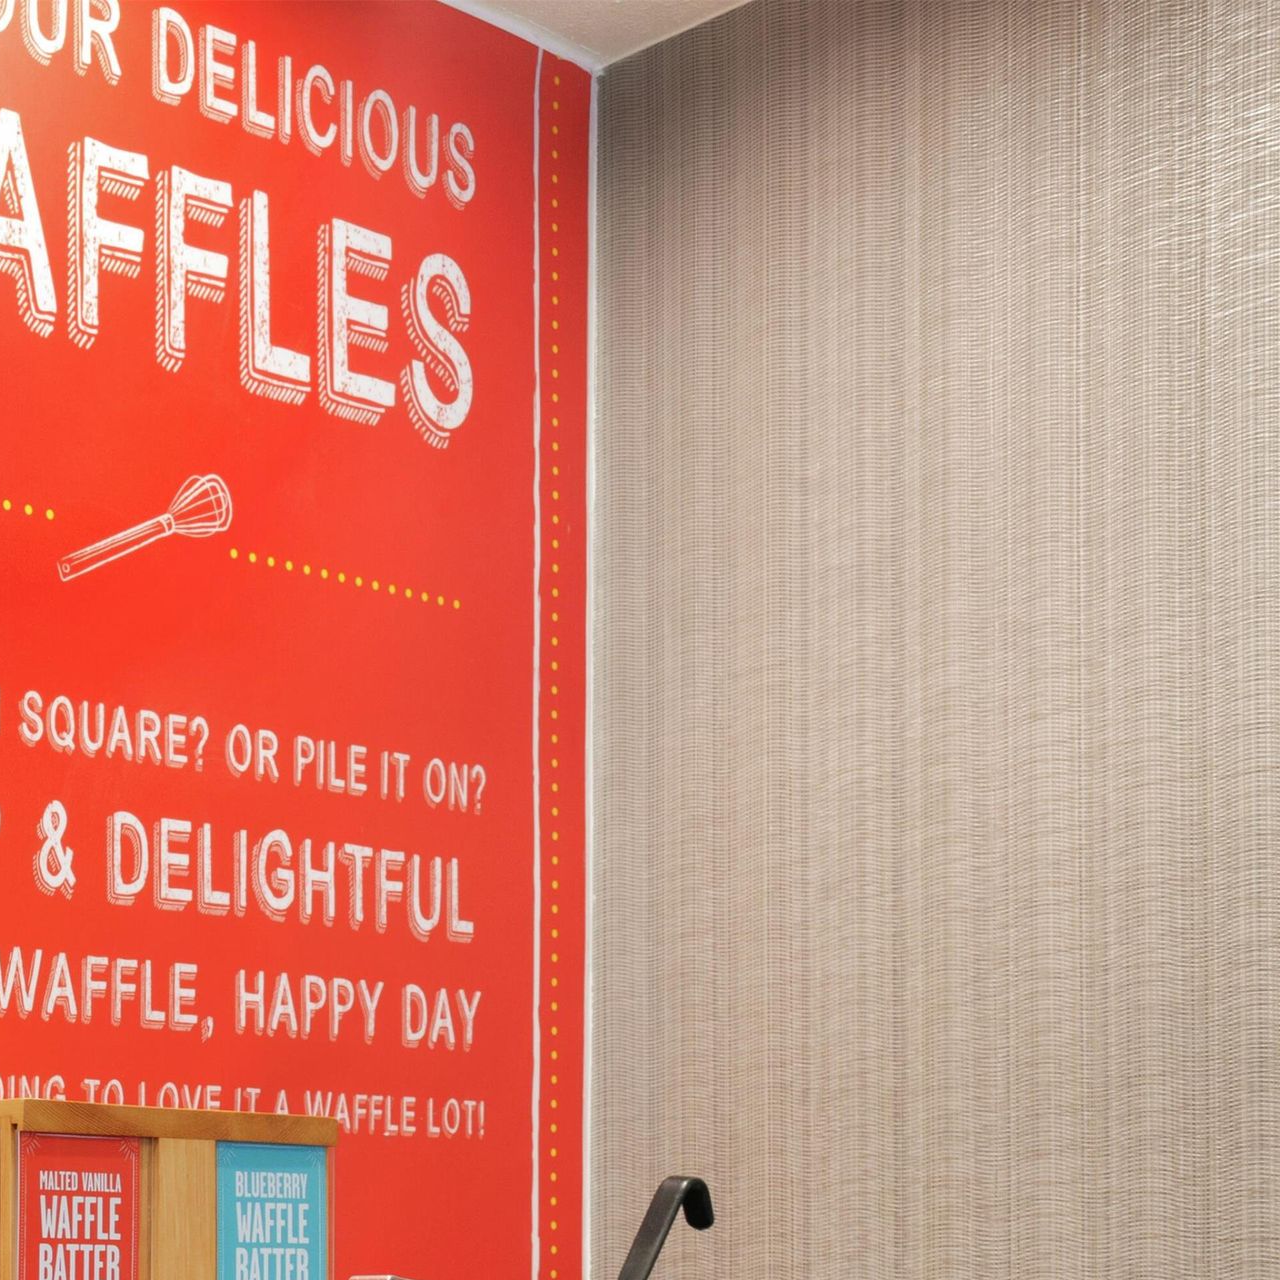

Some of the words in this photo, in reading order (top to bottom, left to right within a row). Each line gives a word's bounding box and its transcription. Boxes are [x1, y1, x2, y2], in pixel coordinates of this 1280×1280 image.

[151, 6, 477, 211] DELICIOUS
[18, 690, 211, 771] SQUARE?
[225, 723, 280, 785] OR
[293, 735, 368, 796] PILE
[379, 751, 411, 800] IT
[423, 757, 487, 814] ON?
[32, 800, 78, 900] &
[104, 809, 476, 944] DELIGHTFUL
[233, 970, 385, 1048] HAPPY
[400, 983, 482, 1053] DAY
[82, 1078, 125, 1106] TO
[273, 1089, 290, 1115] A
[303, 1090, 417, 1136] WAFFLE
[426, 1098, 486, 1137] LOT!
[39, 1170, 78, 1192] MALTED
[81, 1171, 122, 1193] VANILLA
[235, 1170, 308, 1199] BLUEBERRY
[39, 1195, 122, 1240] WAFFLE
[235, 1202, 310, 1244] WAFFLE
